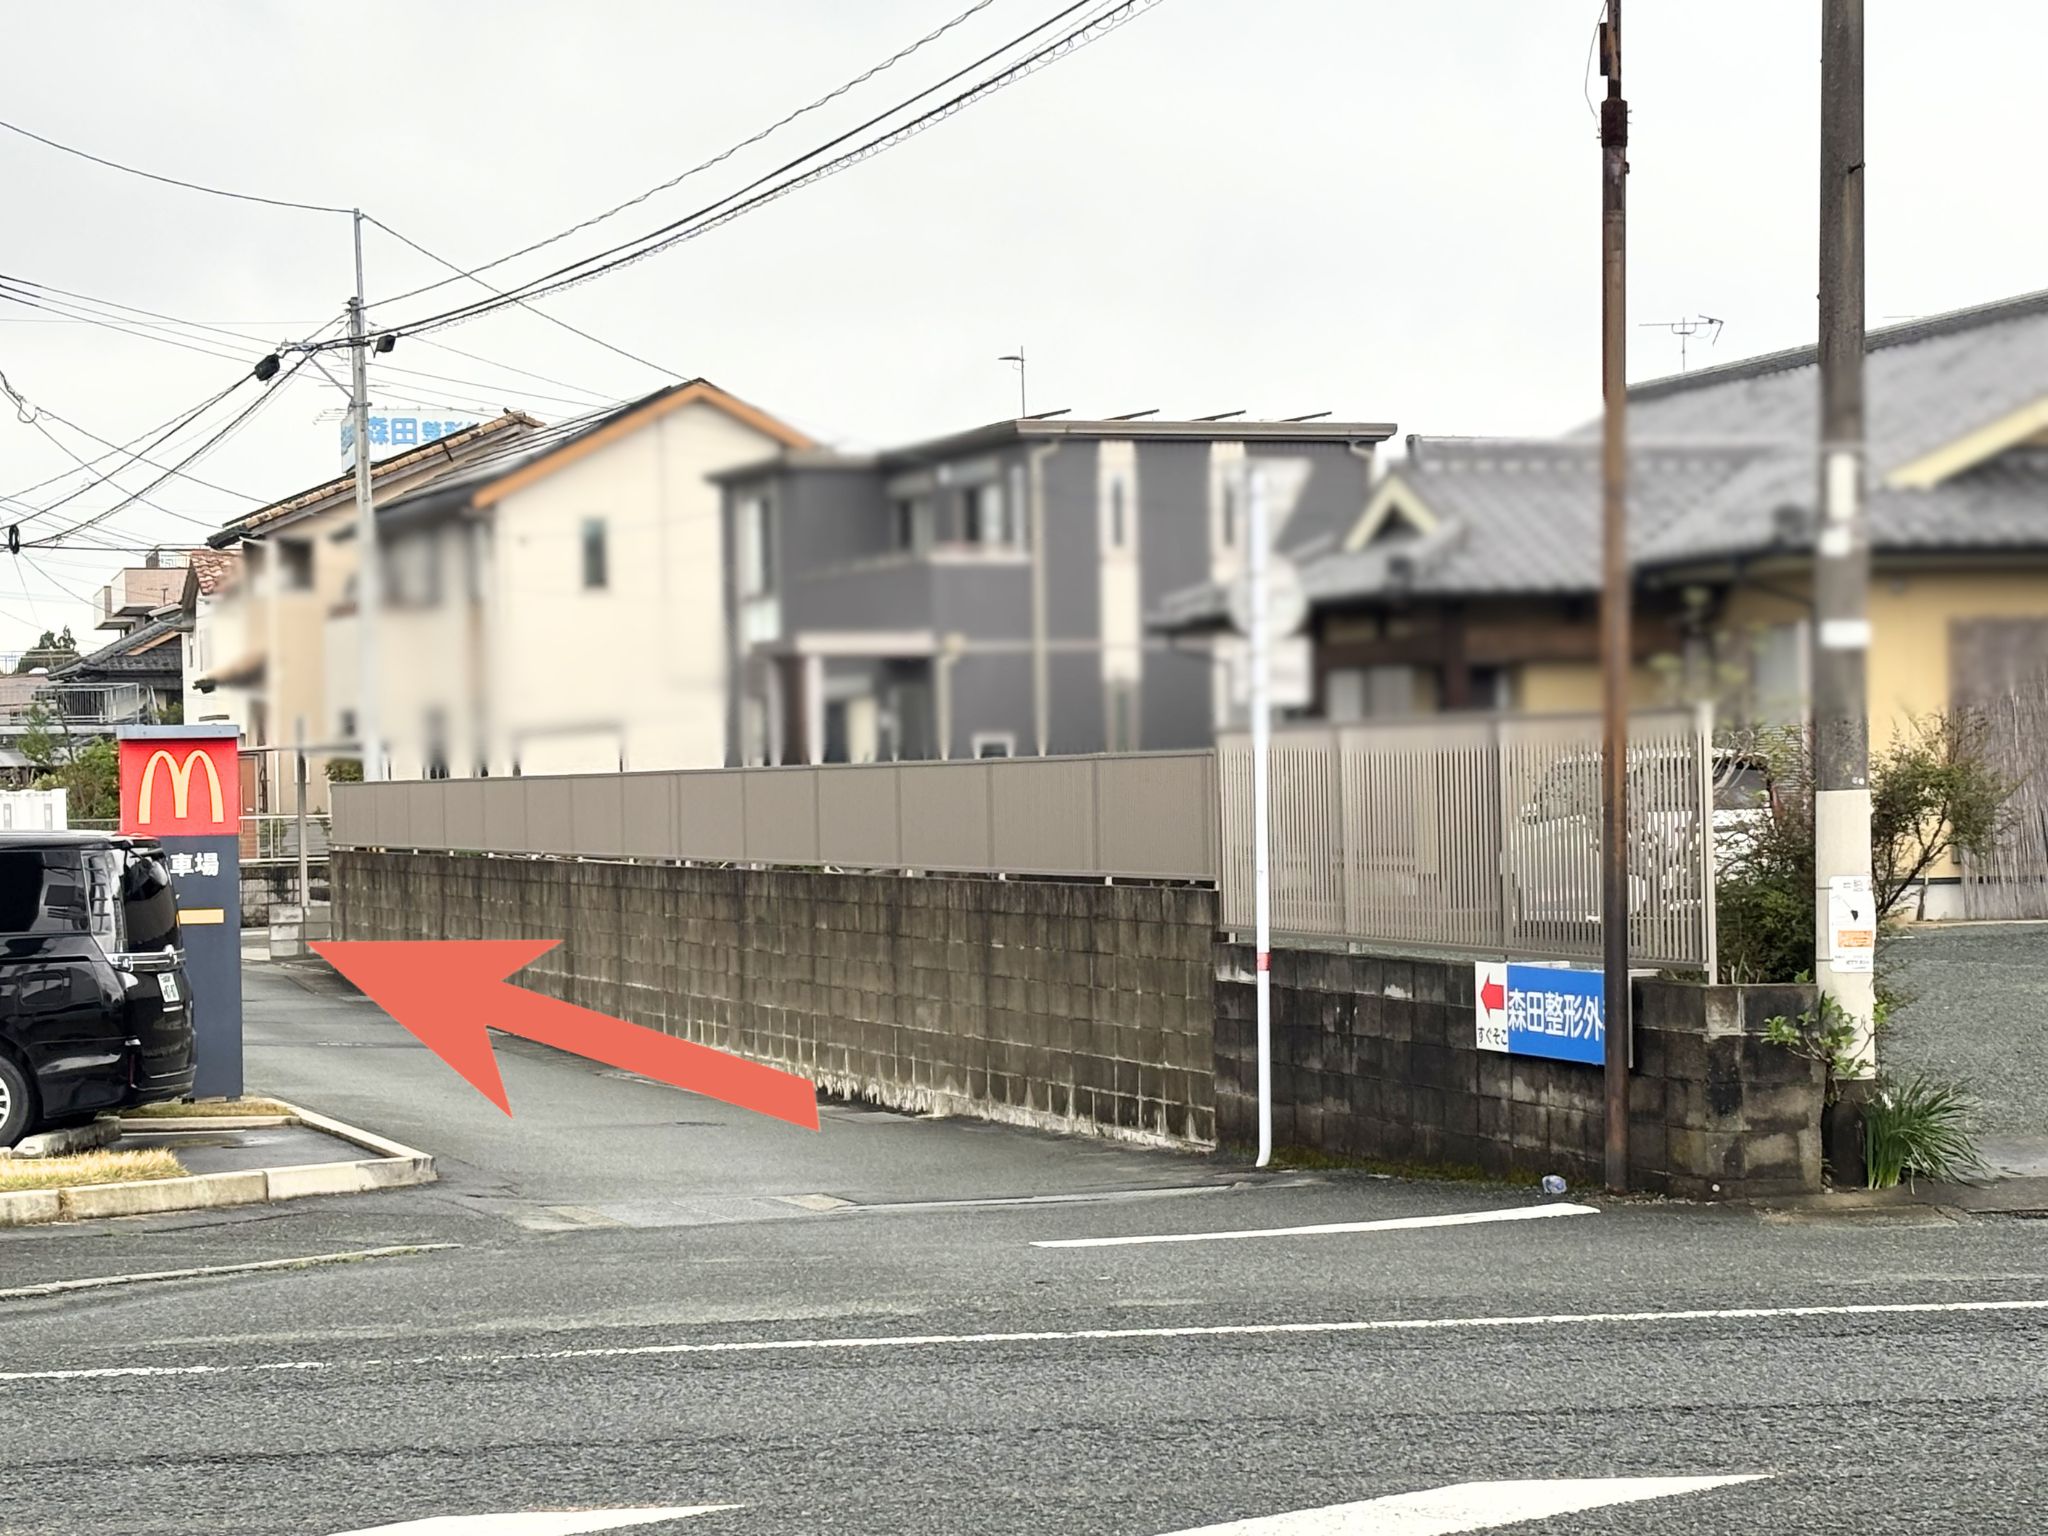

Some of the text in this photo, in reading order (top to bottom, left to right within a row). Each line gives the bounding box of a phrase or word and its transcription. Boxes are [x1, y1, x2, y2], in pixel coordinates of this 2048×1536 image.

[166, 852, 219, 877] 車場
[1508, 988, 1605, 1042] 森田整形外
[1477, 1027, 1508, 1046] すぐそこ
